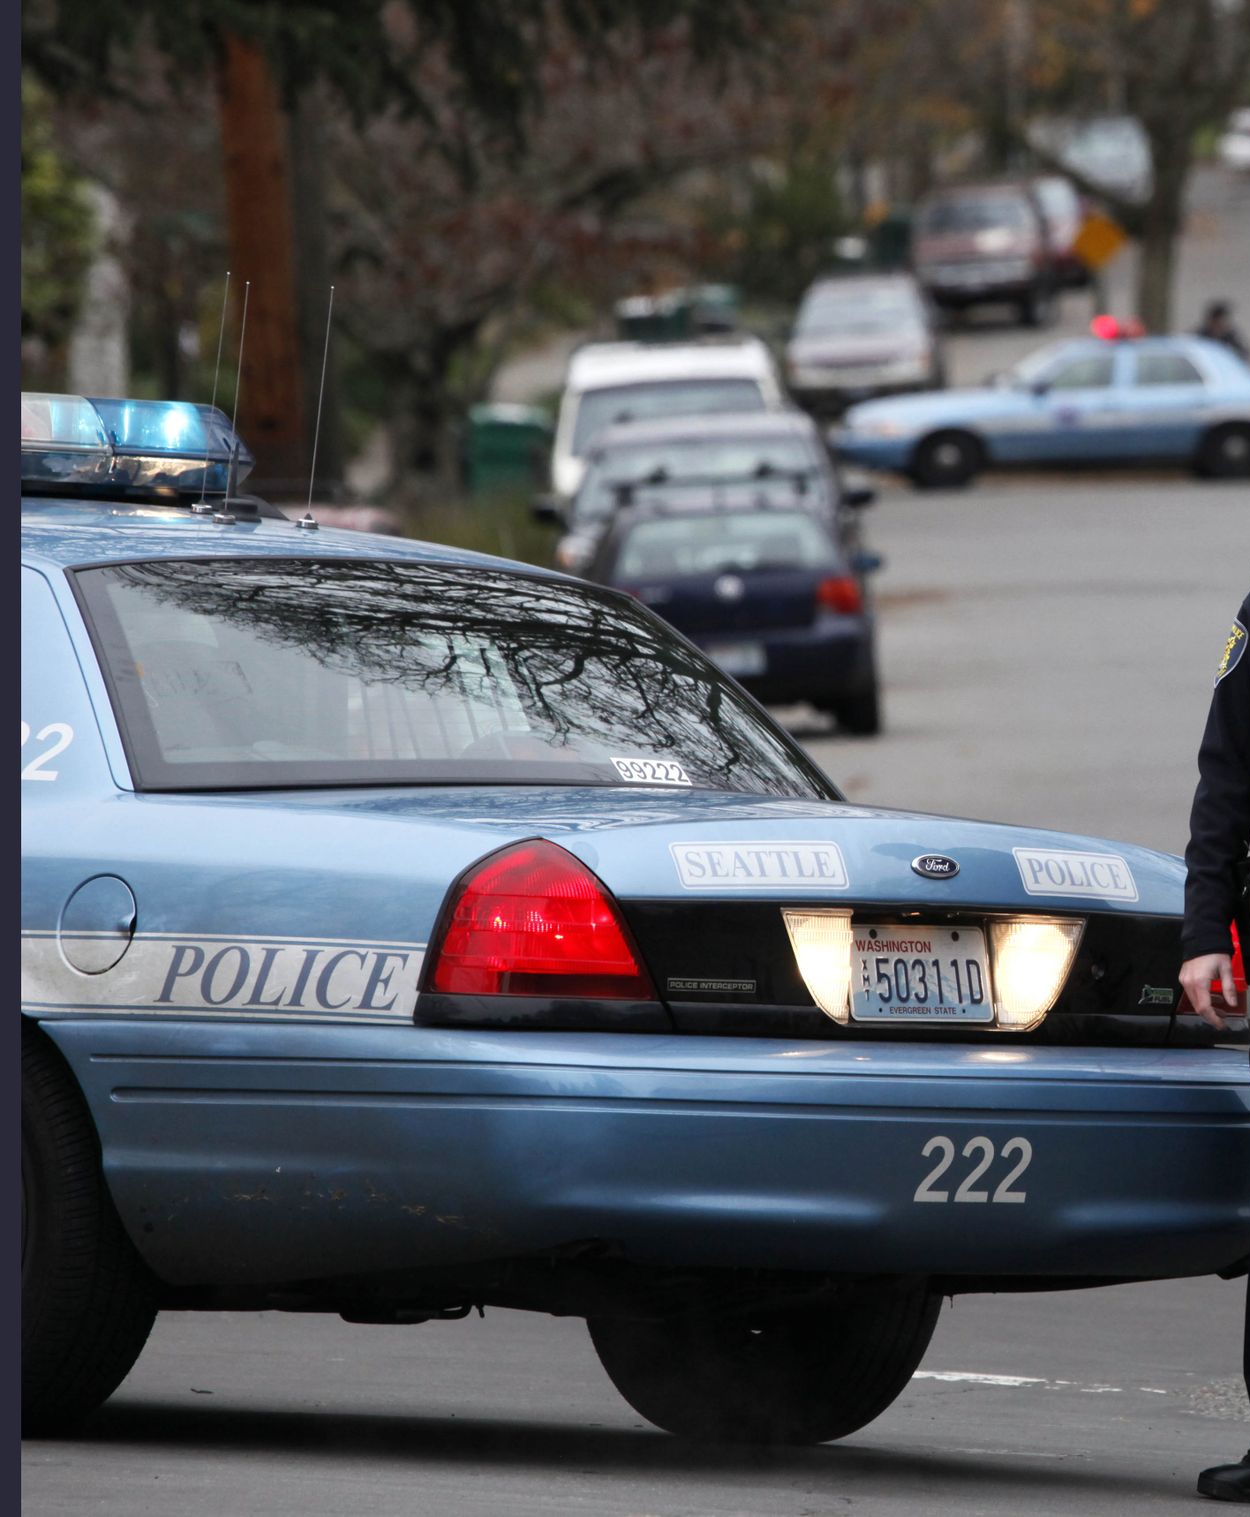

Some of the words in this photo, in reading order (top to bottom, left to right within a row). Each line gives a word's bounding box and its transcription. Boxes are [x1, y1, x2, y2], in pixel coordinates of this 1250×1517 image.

[21, 720, 74, 781] 2
[615, 760, 689, 783] 99222
[684, 850, 836, 879] SEATTLE
[925, 858, 950, 872] Ford
[1025, 857, 1127, 890] POLICE
[855, 940, 932, 953] WASHINGTON
[153, 945, 409, 1011] POLICE
[669, 981, 698, 989] POLICE
[701, 982, 753, 990] INTERCEPTOR
[875, 957, 984, 1004] 50311D
[889, 1006, 931, 1015] EVERGREEN
[934, 1007, 957, 1015] STATE
[913, 1135, 1033, 1203] 222
